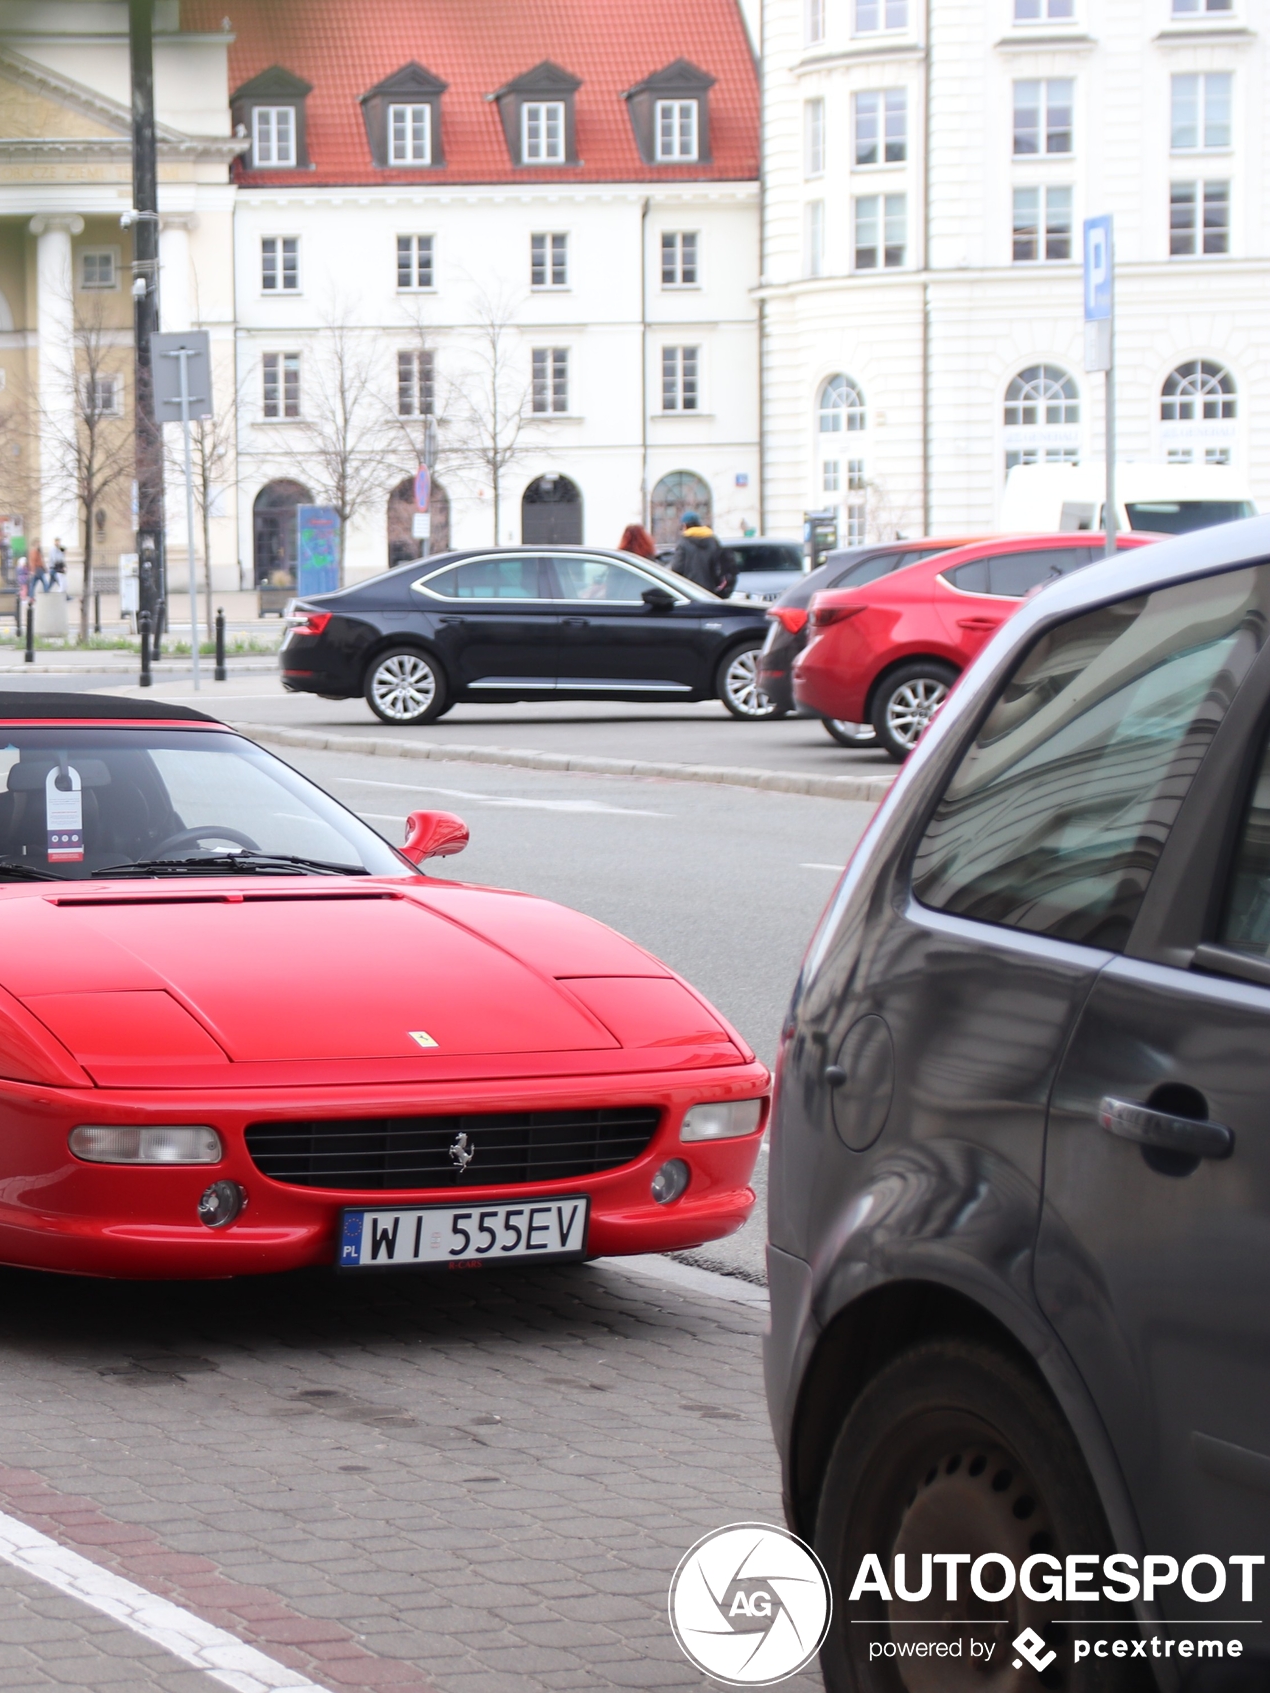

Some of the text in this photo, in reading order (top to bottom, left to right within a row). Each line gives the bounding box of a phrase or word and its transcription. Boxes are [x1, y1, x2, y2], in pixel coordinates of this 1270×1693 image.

[1089, 227, 1106, 307] P
[371, 1205, 579, 1260] WI 555EV
[343, 1245, 359, 1258] PL
[448, 1259, 483, 1270] R-CARS
